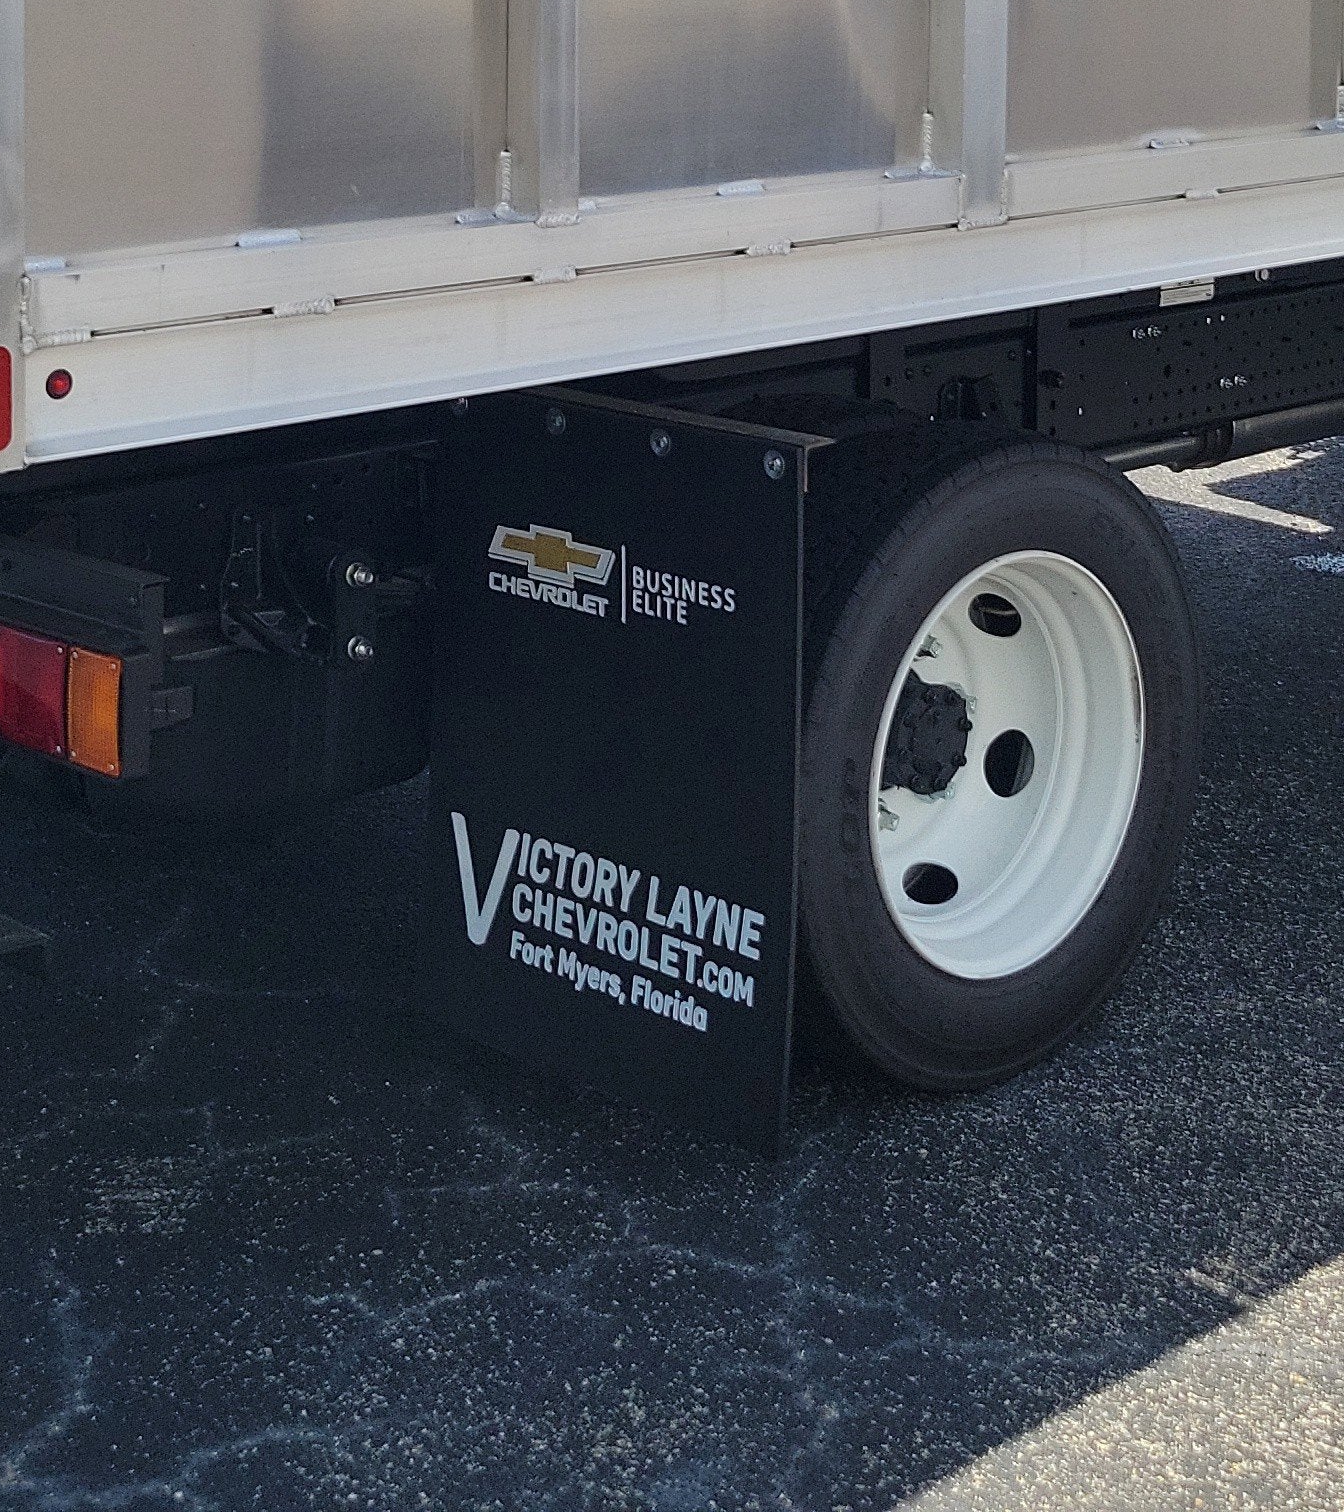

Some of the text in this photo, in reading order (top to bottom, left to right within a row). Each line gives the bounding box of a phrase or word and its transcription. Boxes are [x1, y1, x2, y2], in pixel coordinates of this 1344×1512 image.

[489, 571, 609, 617] CHEVROLET
[632, 565, 736, 613] BUSINESS
[632, 589, 688, 625] ELITE
[451, 811, 765, 961] VICTORY LAYNE
[509, 930, 708, 1032] Fort Myers, Florida
[512, 884, 754, 1007] CHEVROLET.COM
